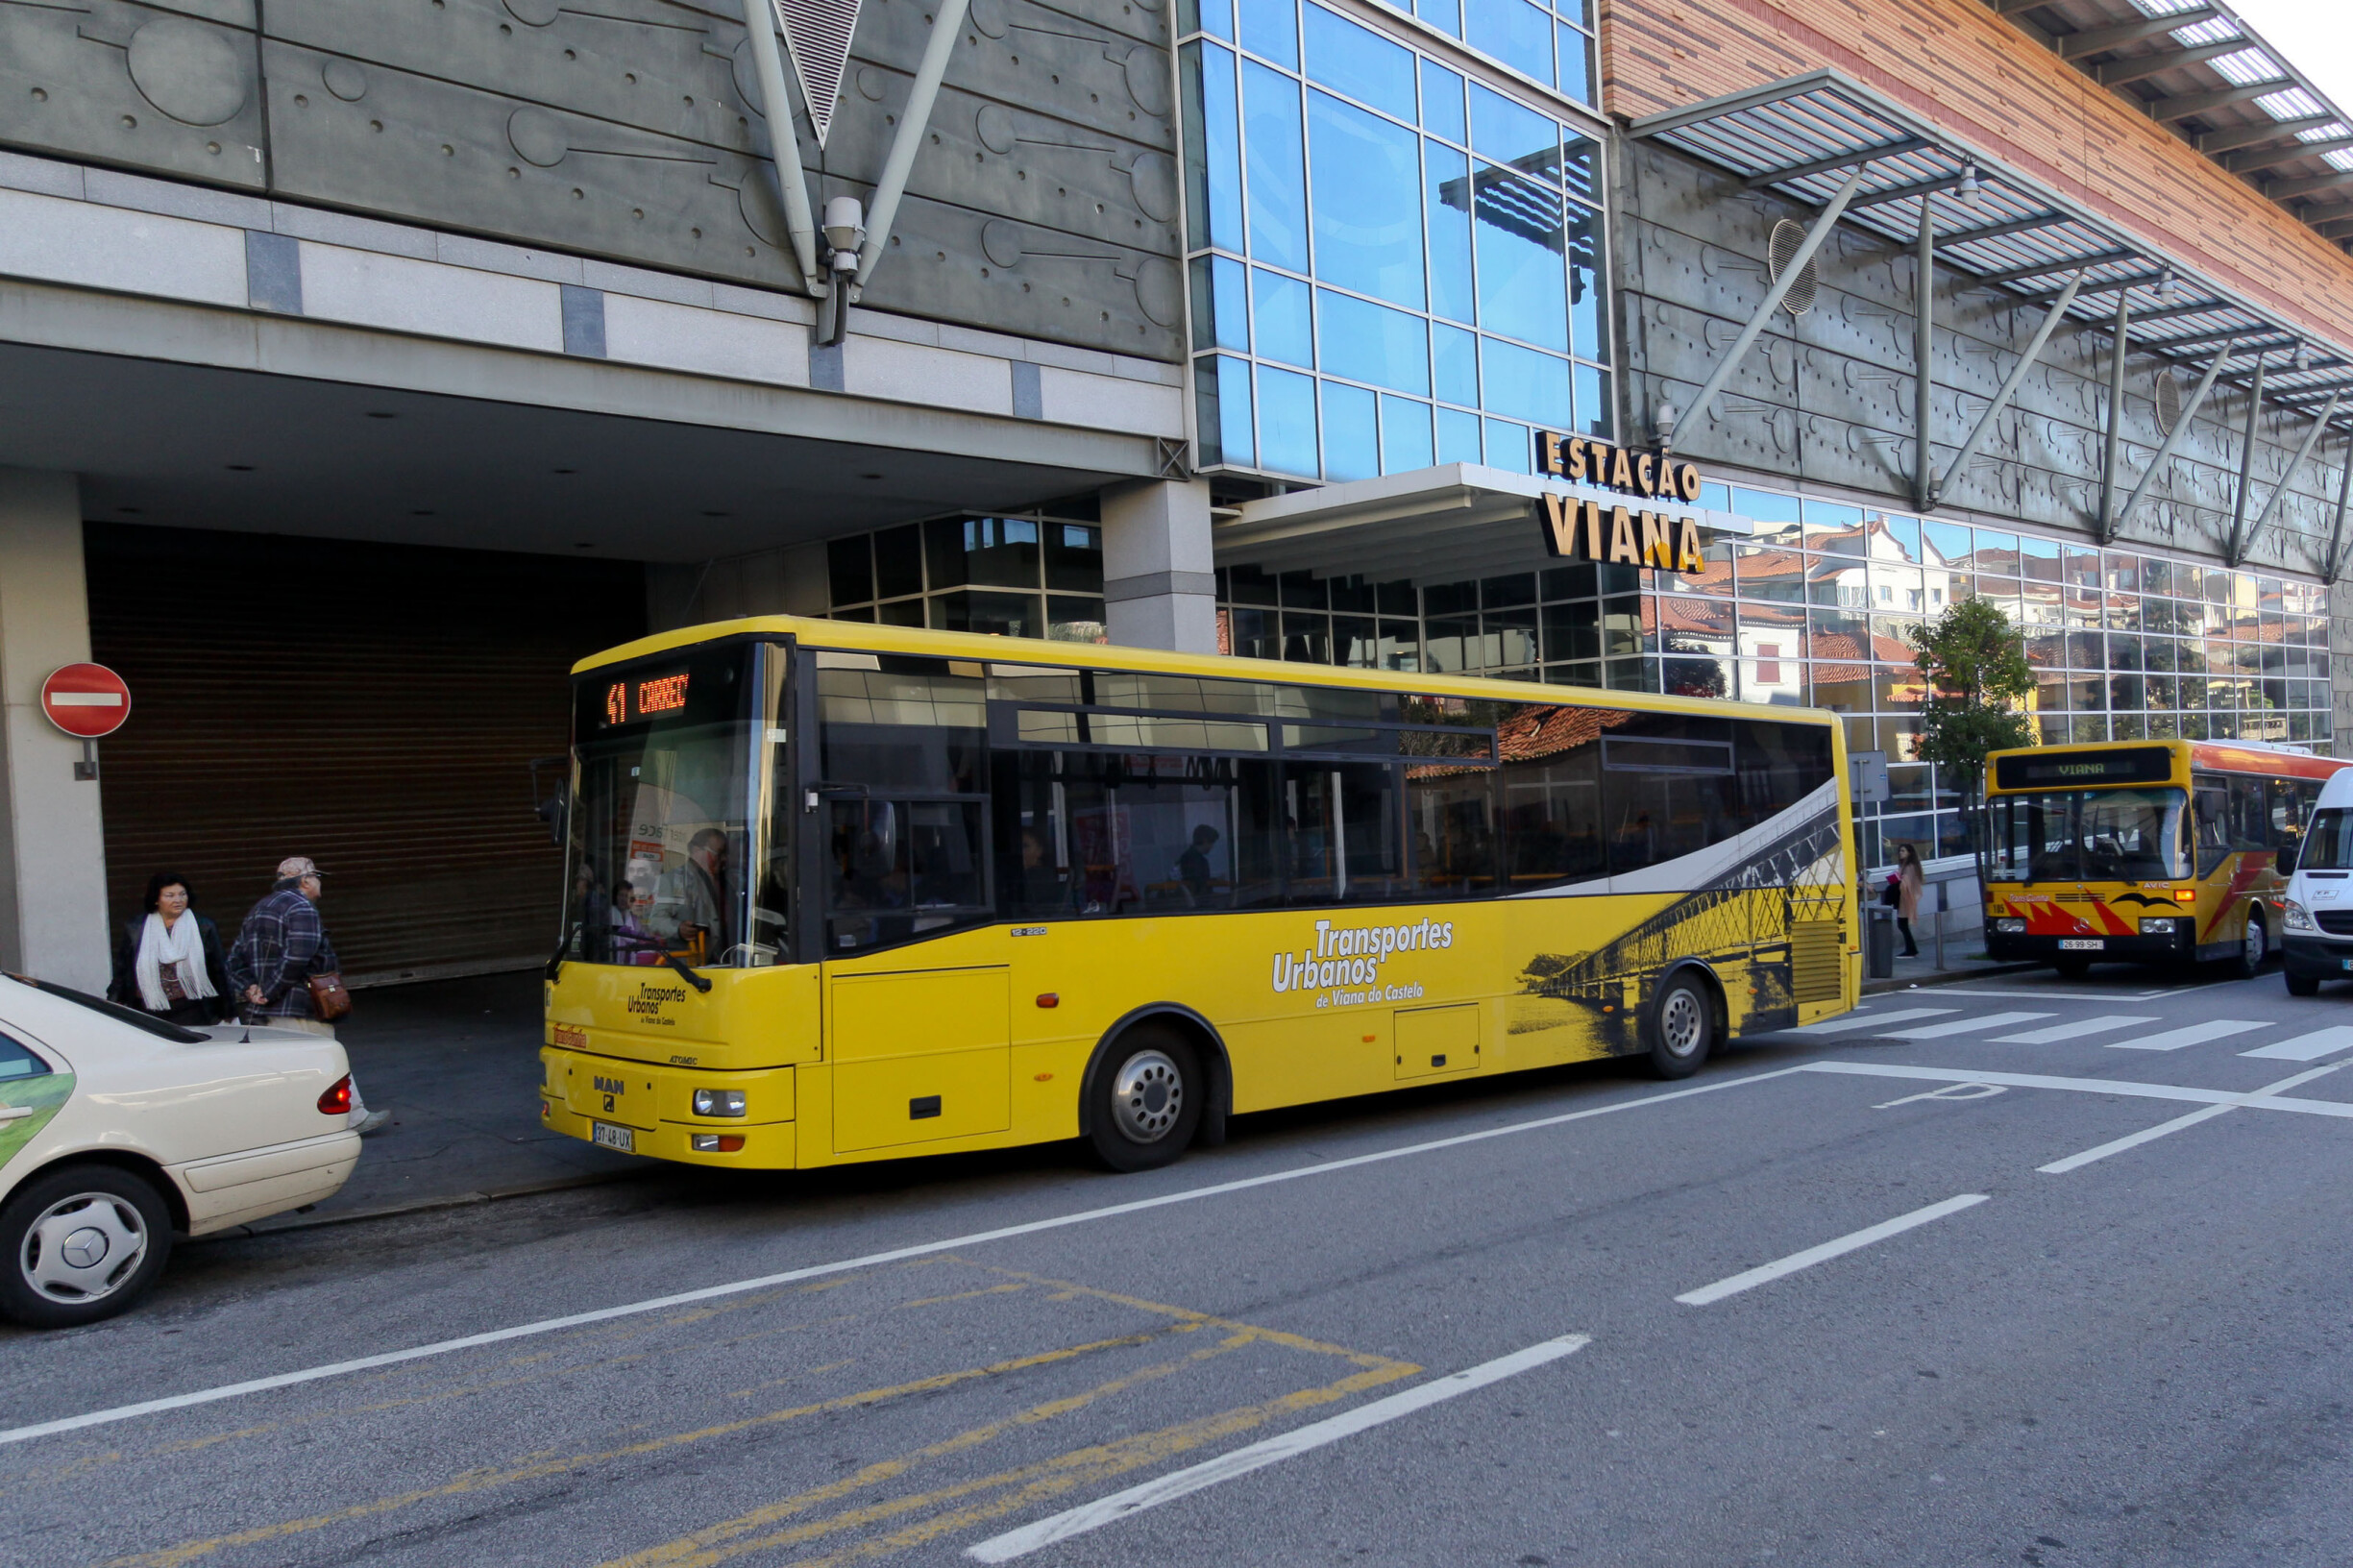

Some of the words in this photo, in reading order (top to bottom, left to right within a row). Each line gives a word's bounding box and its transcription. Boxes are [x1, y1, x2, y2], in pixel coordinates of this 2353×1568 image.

[1543, 431, 1702, 502] ESTAÇÃO
[1543, 492, 1705, 574] VIANA
[2059, 764, 2104, 775] VIANA
[1314, 917, 1454, 963] Transportes
[1271, 949, 1378, 993] Urbanos
[627, 995, 659, 1015] Urbanos
[639, 982, 686, 1006] Transportes
[1315, 993, 1329, 1009] de
[1332, 989, 1365, 1007] Viana
[1368, 986, 1382, 1003] do
[1385, 980, 1424, 1001] Castelo
[669, 1055, 698, 1066] ATOMIC
[594, 1075, 625, 1095] MAN
